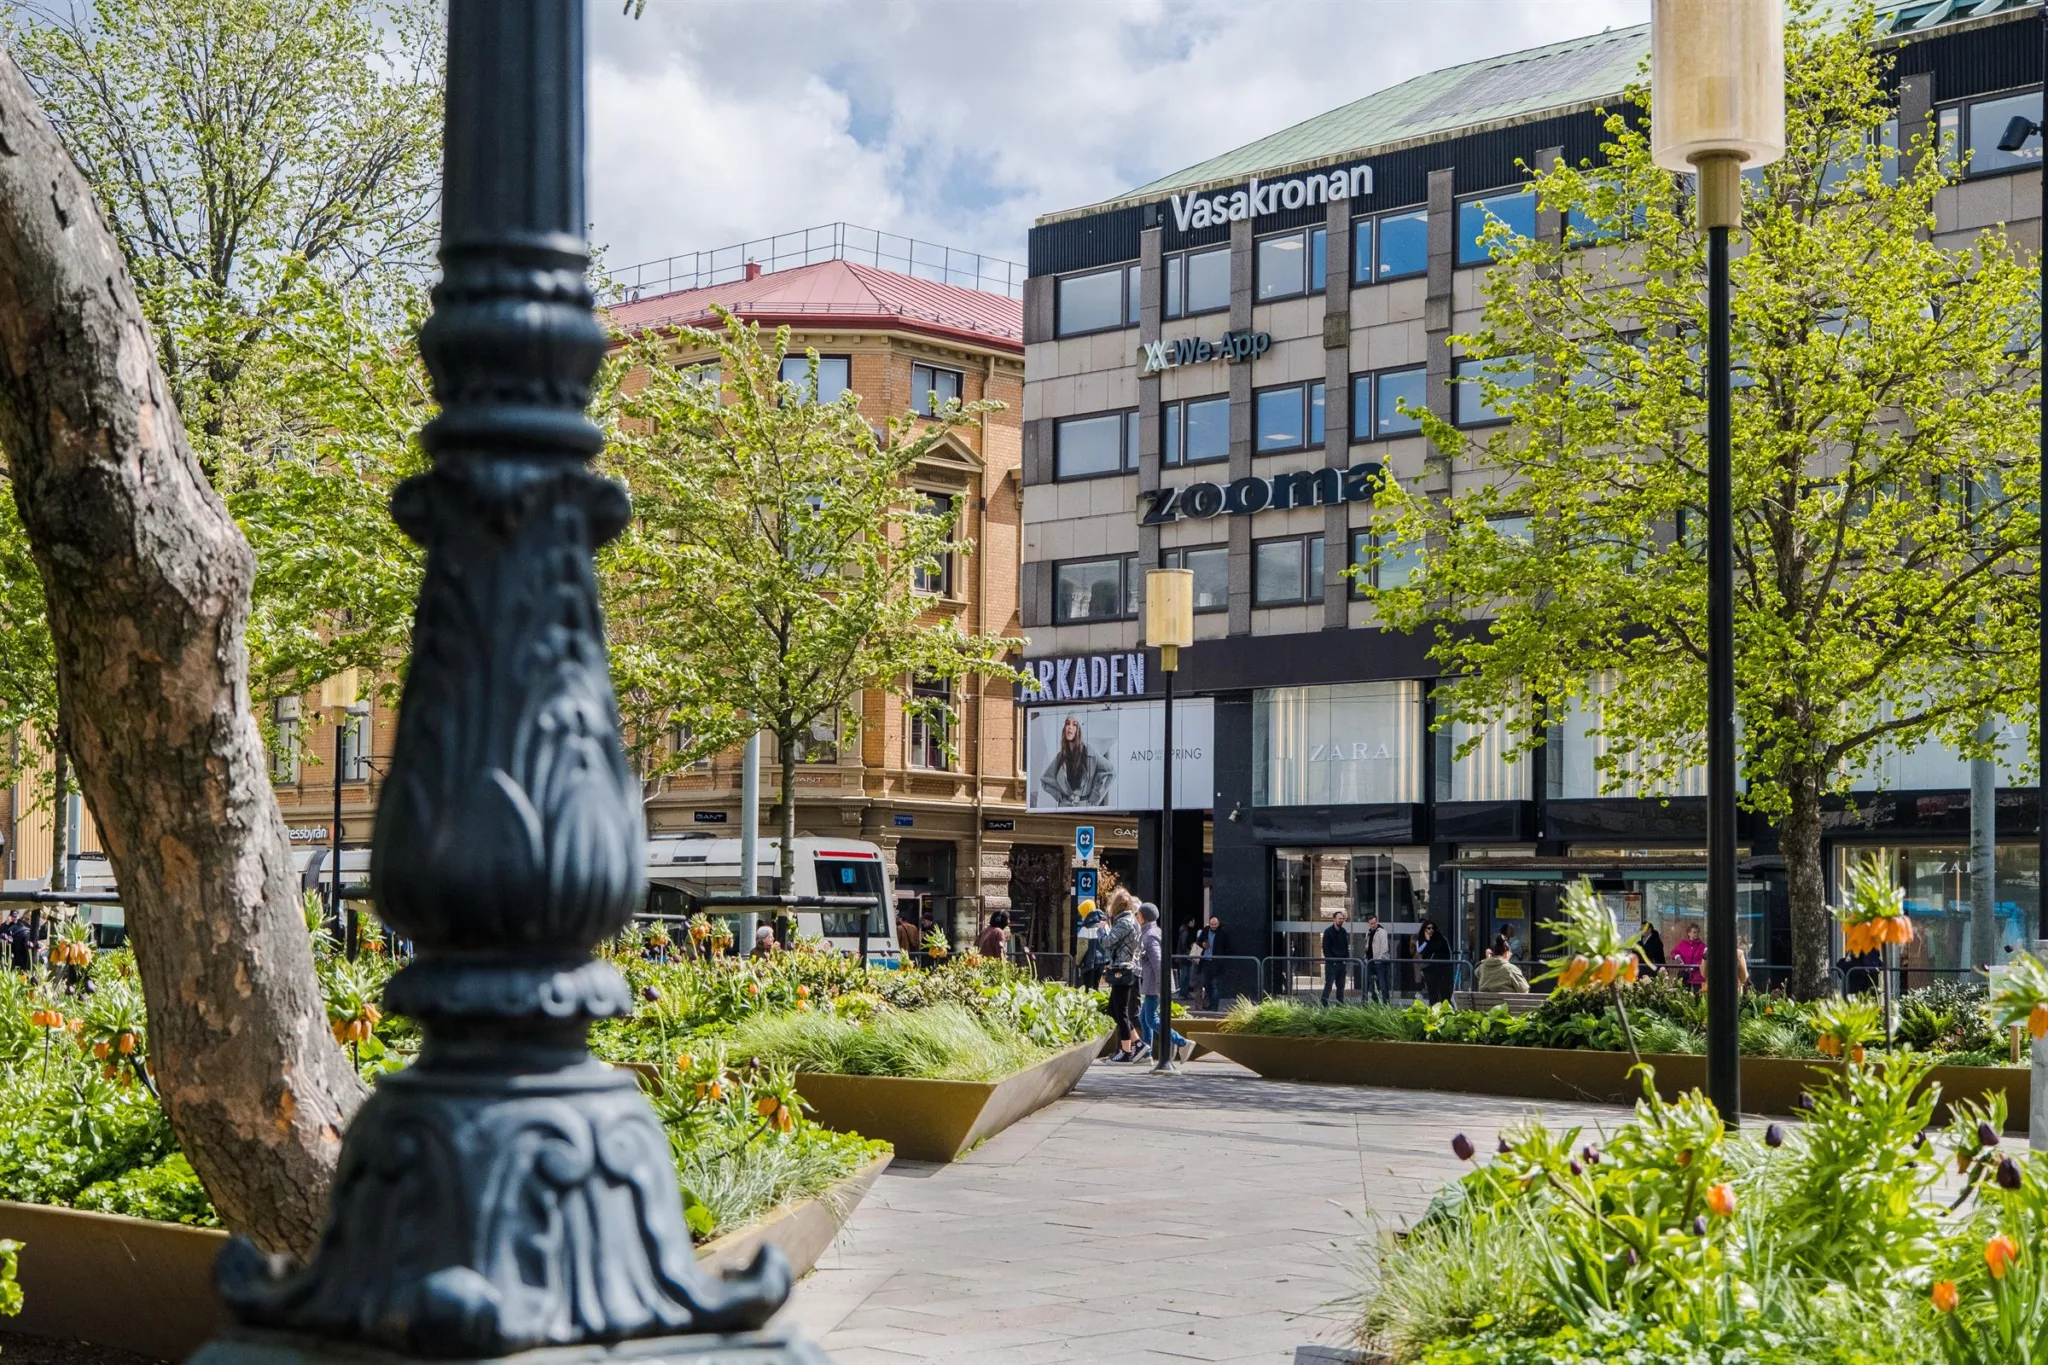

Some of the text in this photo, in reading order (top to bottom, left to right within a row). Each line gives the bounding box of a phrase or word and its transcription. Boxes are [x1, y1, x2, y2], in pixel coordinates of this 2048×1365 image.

[1171, 163, 1374, 232] Vasakronan
[1173, 331, 1271, 366] We App
[1143, 462, 1388, 526] zooma
[1020, 652, 1145, 703] ARKADEN
[1130, 749, 1154, 761] AND
[1170, 747, 1202, 761] PRING
[1309, 742, 1393, 762] ZARA
[1080, 834, 1091, 845] C2
[1113, 828, 1139, 837] GAN
[1081, 877, 1092, 888] C2
